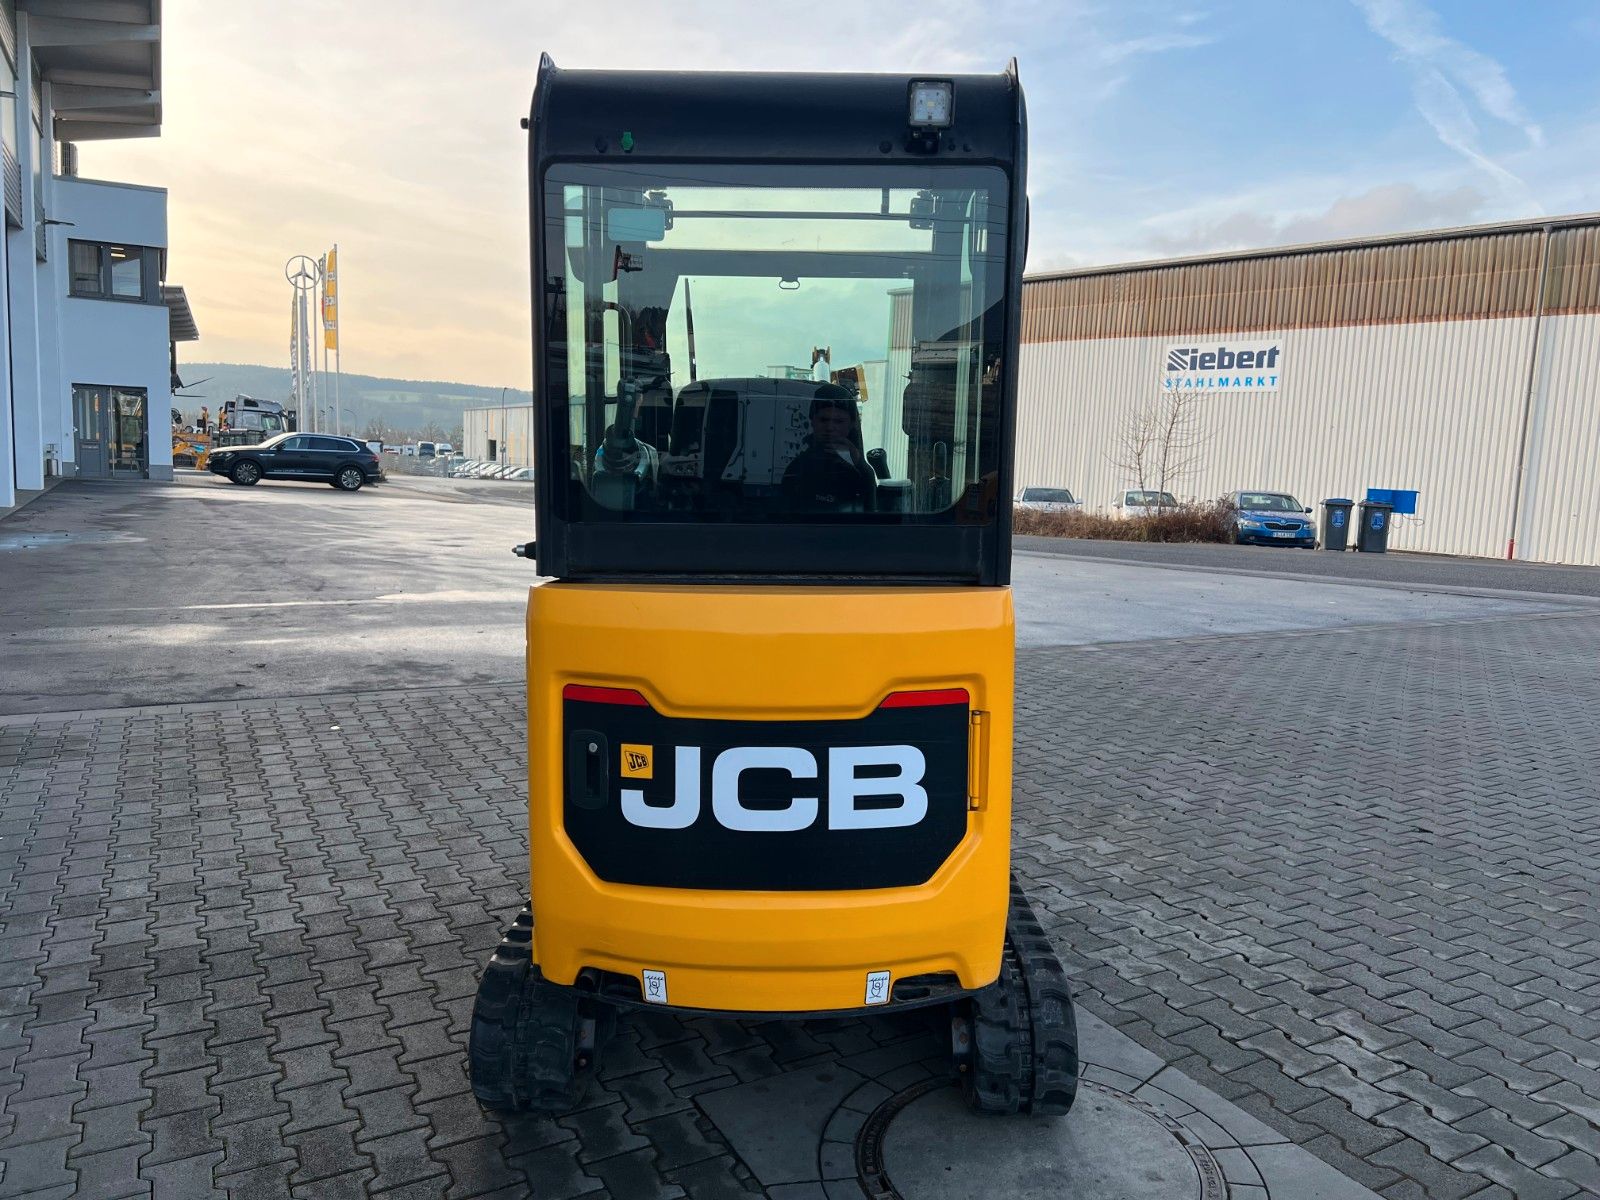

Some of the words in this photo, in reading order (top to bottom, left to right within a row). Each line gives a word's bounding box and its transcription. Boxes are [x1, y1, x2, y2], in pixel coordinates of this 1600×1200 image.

[1167, 346, 1279, 371] Siebert
[1164, 376, 1277, 388] STAHLMARKT
[629, 753, 647, 769] JCB
[621, 745, 928, 831] JCB
